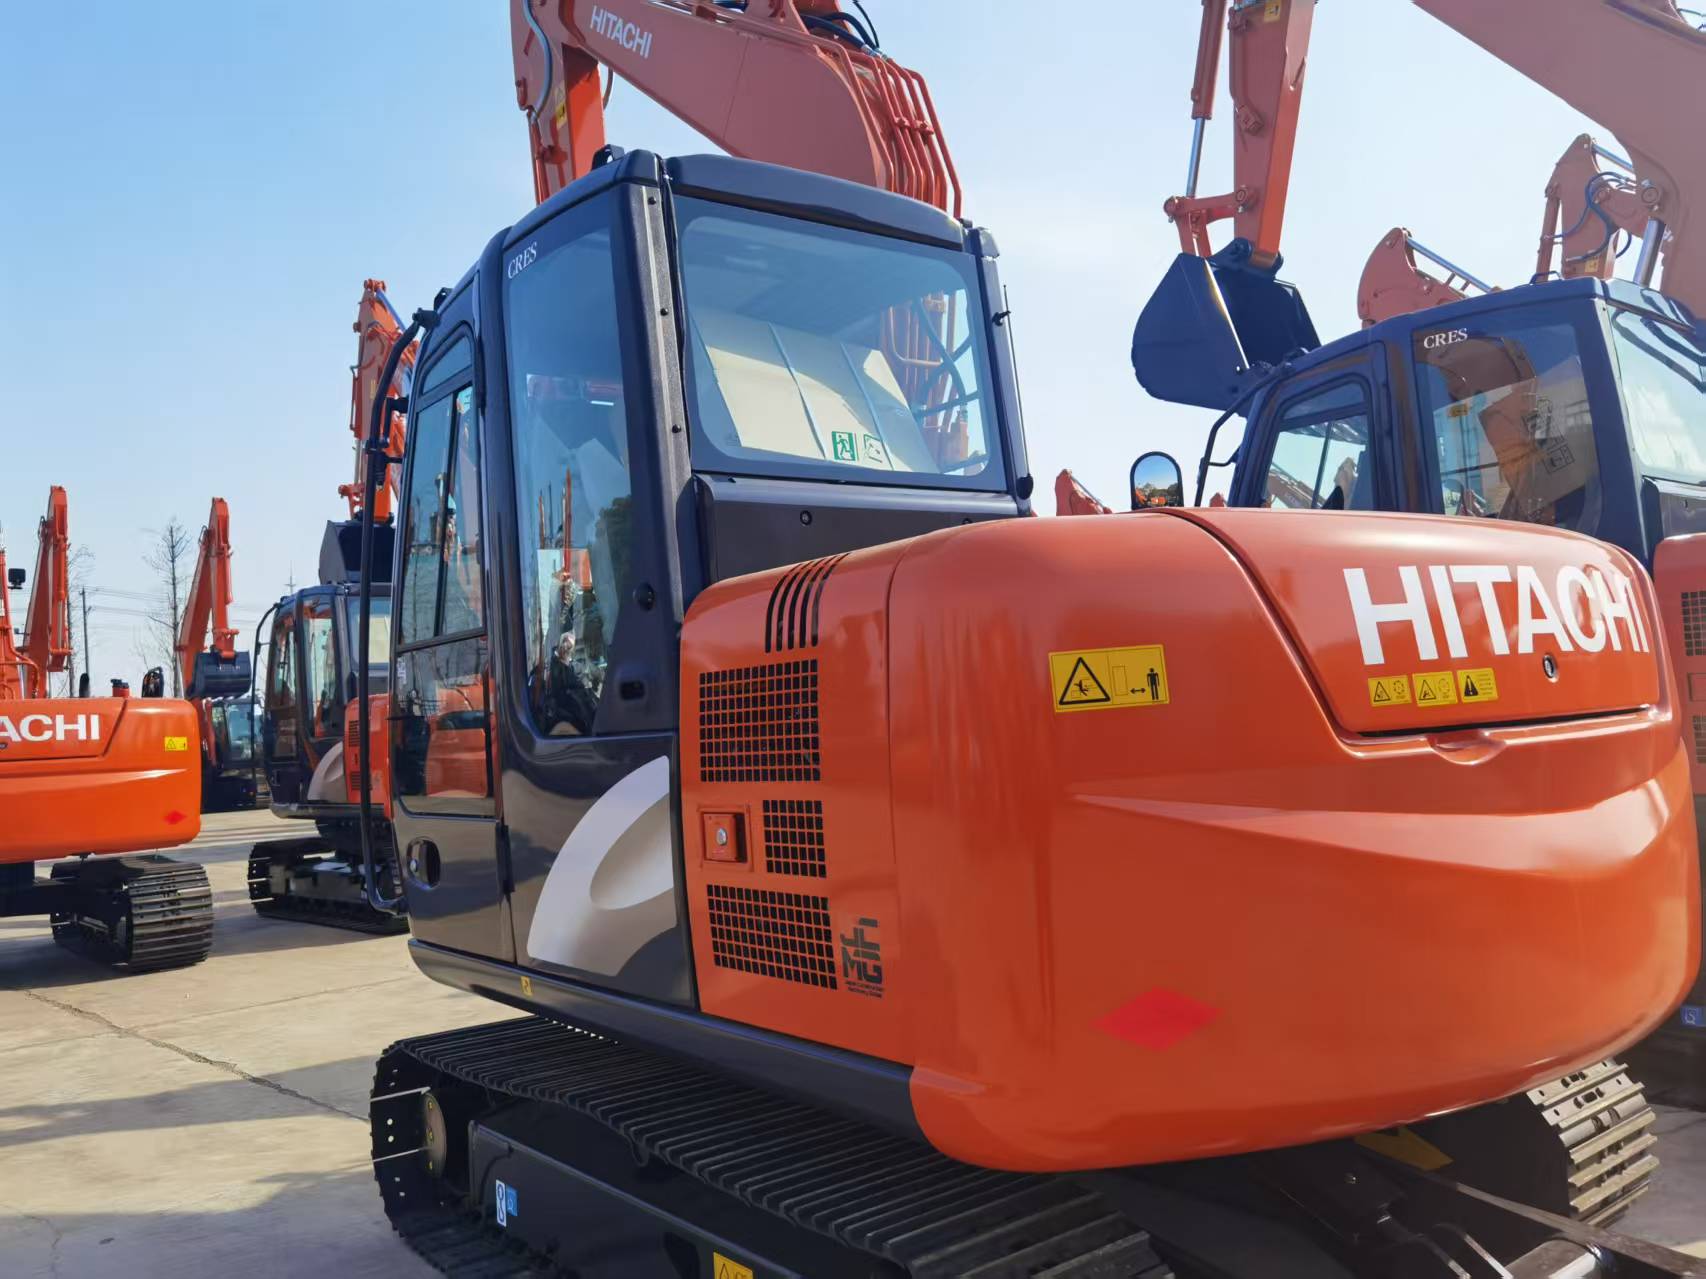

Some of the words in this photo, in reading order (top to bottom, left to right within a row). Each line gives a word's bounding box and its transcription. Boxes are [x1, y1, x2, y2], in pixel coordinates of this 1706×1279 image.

[590, 6, 653, 58] HITACHI
[508, 242, 537, 279] CRES
[1423, 328, 1469, 349] CRES
[1343, 564, 1650, 666] HITACHI
